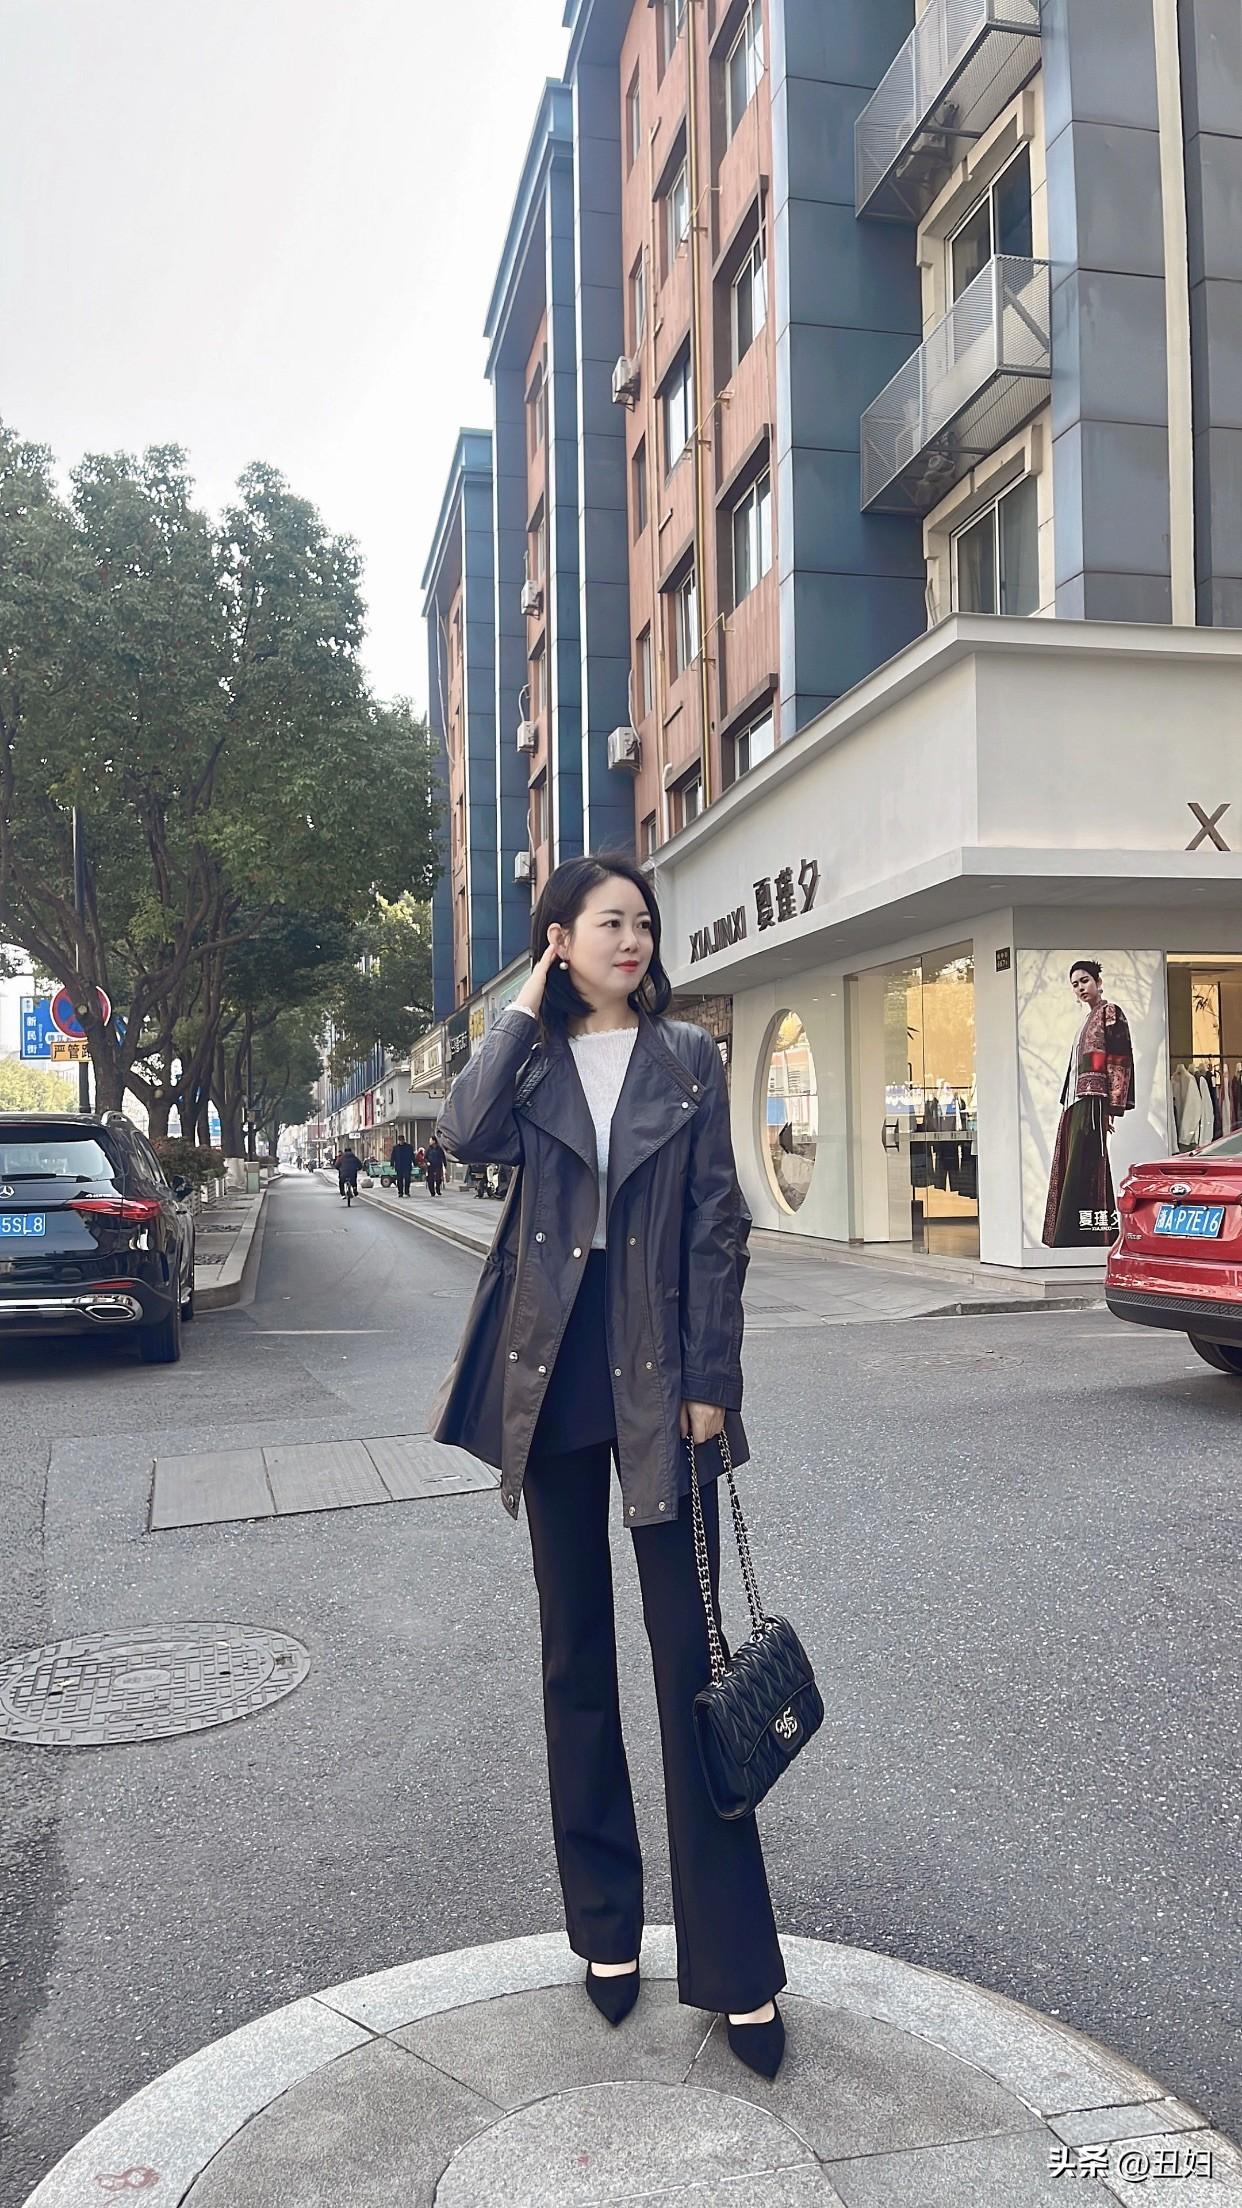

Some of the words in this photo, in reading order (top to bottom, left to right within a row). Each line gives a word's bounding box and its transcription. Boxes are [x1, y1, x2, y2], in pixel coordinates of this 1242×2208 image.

[1184, 803, 1232, 851] X
[689, 905, 748, 964] XIAJINXI
[753, 859, 819, 932] 夏瑾夕
[1, 1216, 43, 1234] 5SL8
